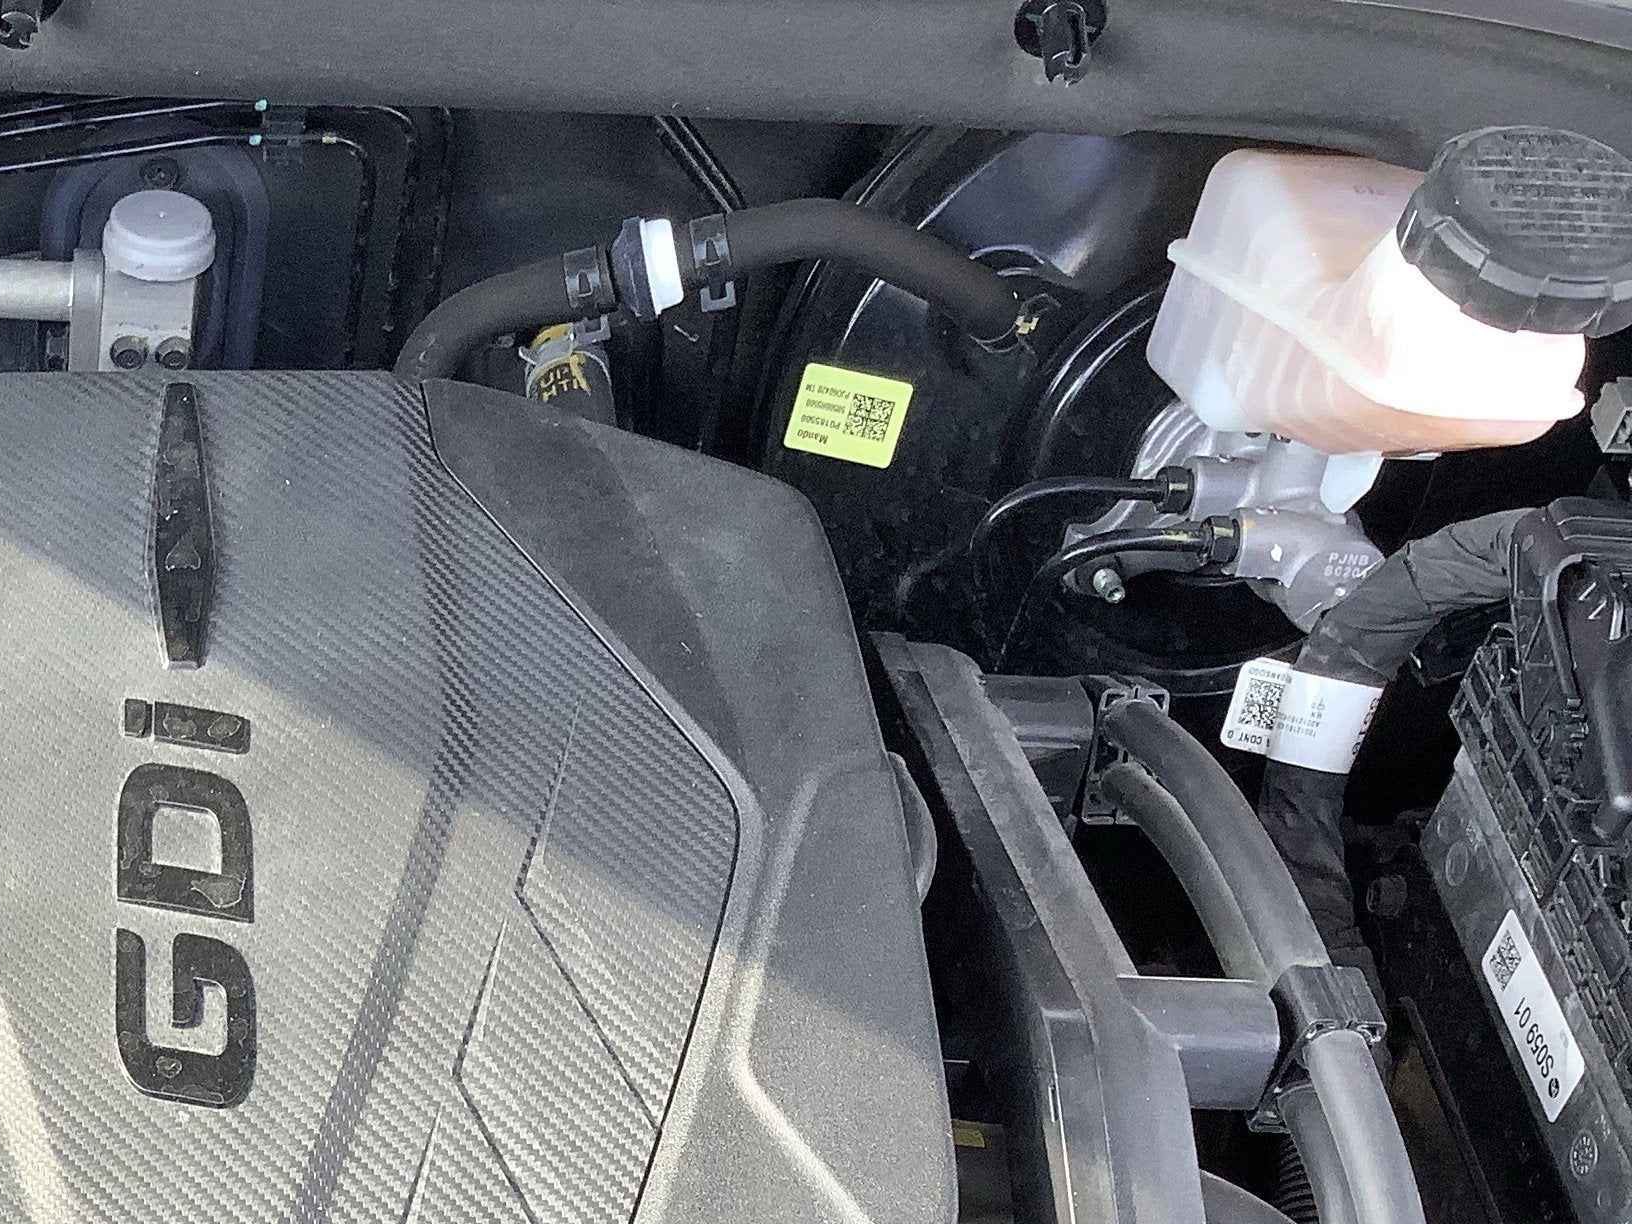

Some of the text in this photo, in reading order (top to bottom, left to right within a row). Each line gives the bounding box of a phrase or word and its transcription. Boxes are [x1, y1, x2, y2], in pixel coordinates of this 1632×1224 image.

[797, 429, 828, 444] Mando
[115, 698, 258, 1109] GDi
[1513, 996, 1555, 1079] S059 01
